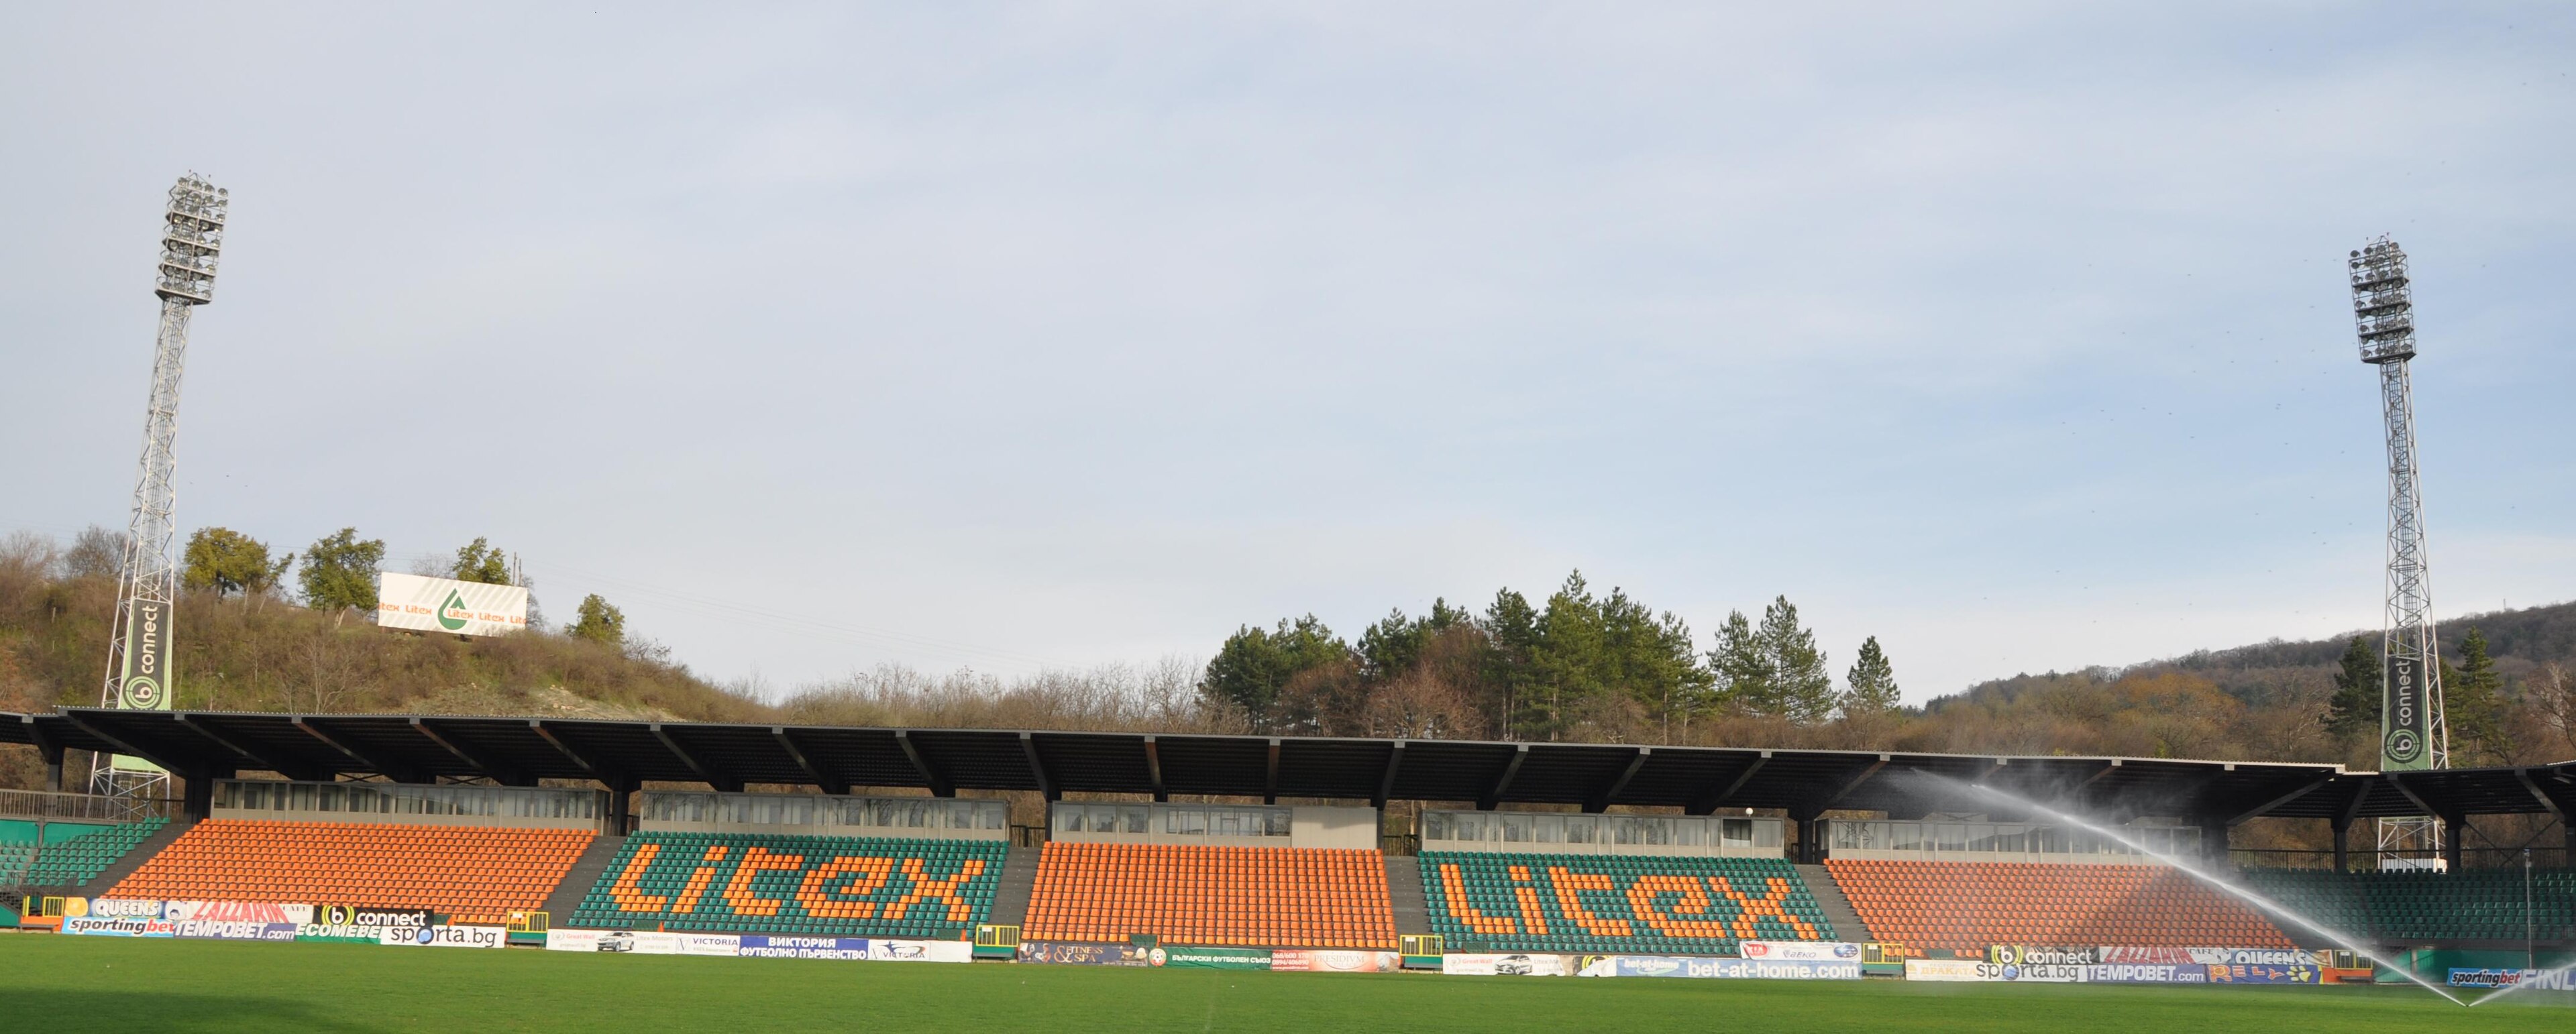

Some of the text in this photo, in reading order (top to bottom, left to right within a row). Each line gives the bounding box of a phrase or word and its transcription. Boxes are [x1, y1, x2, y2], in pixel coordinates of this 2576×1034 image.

[405, 605, 432, 616] Litex
[447, 609, 474, 620] Litex
[479, 612, 504, 622] Litex
[141, 606, 158, 674] connect
[2396, 660, 2412, 727] connect
[95, 900, 159, 917] QUEENS
[70, 918, 174, 935] sportingbet
[356, 911, 426, 927] connect
[175, 920, 294, 939] TEMPOBET.com
[391, 925, 496, 947] sporta.bg
[693, 937, 738, 945] VICTORIA
[768, 937, 836, 947] ВИКТОРИЯ
[740, 947, 797, 958] ФУТБОЛНО
[798, 949, 867, 960] ПЪРВЕНСТВО
[1073, 954, 1095, 962] SPA
[2026, 949, 2093, 964] connect
[1688, 960, 1859, 979] bet-at-home.com
[2088, 965, 2204, 982] TEMPOBET.com
[2452, 970, 2521, 986] sportingbet
